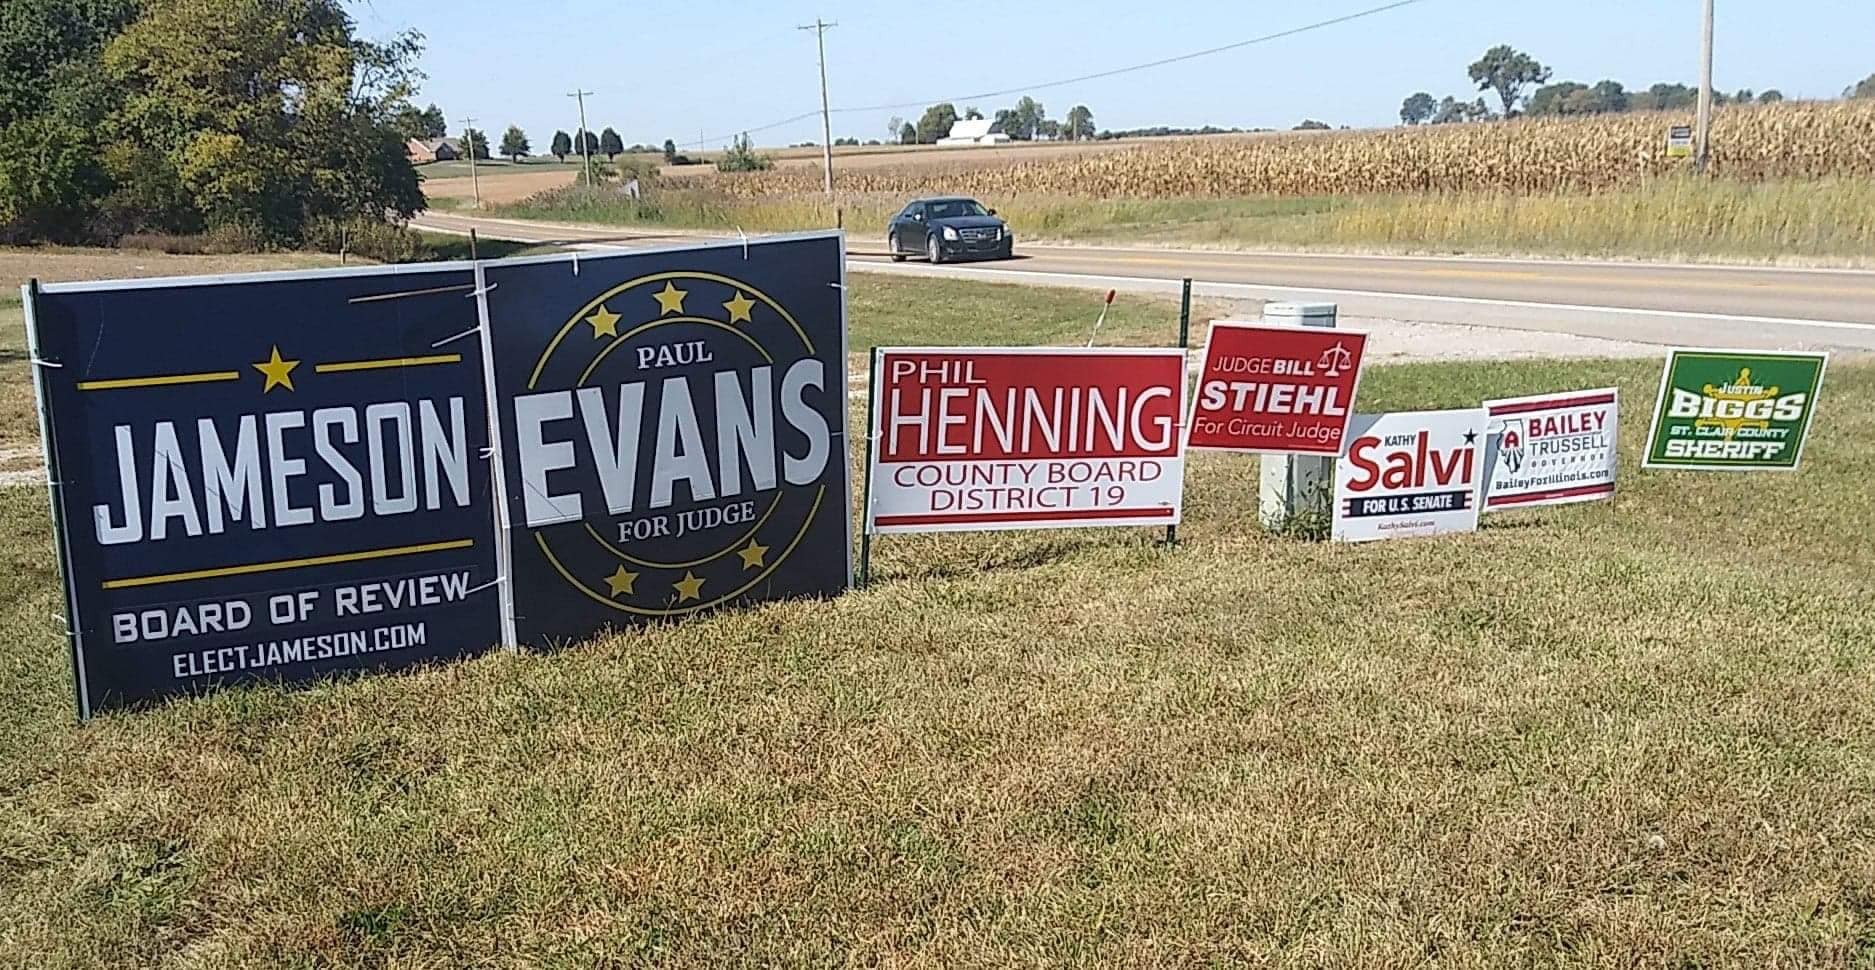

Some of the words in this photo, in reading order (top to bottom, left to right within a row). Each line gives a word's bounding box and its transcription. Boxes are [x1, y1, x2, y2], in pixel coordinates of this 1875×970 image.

[637, 340, 712, 370] PAUL
[1212, 357, 1272, 374] JUDGE
[1272, 359, 1315, 376] BILL
[892, 360, 987, 384] PHIL
[1200, 380, 1345, 416] STIEHL
[1667, 387, 1807, 421] BIGGS
[888, 386, 1172, 456] HENNING
[1194, 416, 1224, 434] For
[1227, 417, 1283, 437] Circuit
[1286, 421, 1341, 443] Judge
[1529, 410, 1607, 438] BAILEY
[1670, 425, 1692, 436] ST.
[1696, 426, 1735, 437] CLAIR
[1737, 427, 1790, 439] COUNTY
[514, 358, 831, 527] EVANS
[1384, 434, 1416, 447] KATHY
[1529, 435, 1608, 456] TRUSSELL
[1664, 438, 1786, 460] SHERIFF
[93, 396, 471, 545] JAMESON
[894, 463, 1038, 487] COUNTY
[1048, 460, 1162, 483] BOARD
[1346, 430, 1475, 492] Salvi
[931, 487, 1079, 511] DISTRICT
[1091, 486, 1125, 506] 19
[1363, 499, 1386, 514] FOR
[1388, 498, 1411, 513] U.S.
[1412, 495, 1454, 510] SENATE
[617, 517, 670, 543] FOR
[676, 501, 756, 538] JUDGE
[112, 599, 252, 643] BOARD
[269, 591, 319, 624] OF
[335, 571, 470, 616] REVIEW
[173, 622, 427, 678] ELECTJAMESON.COM
